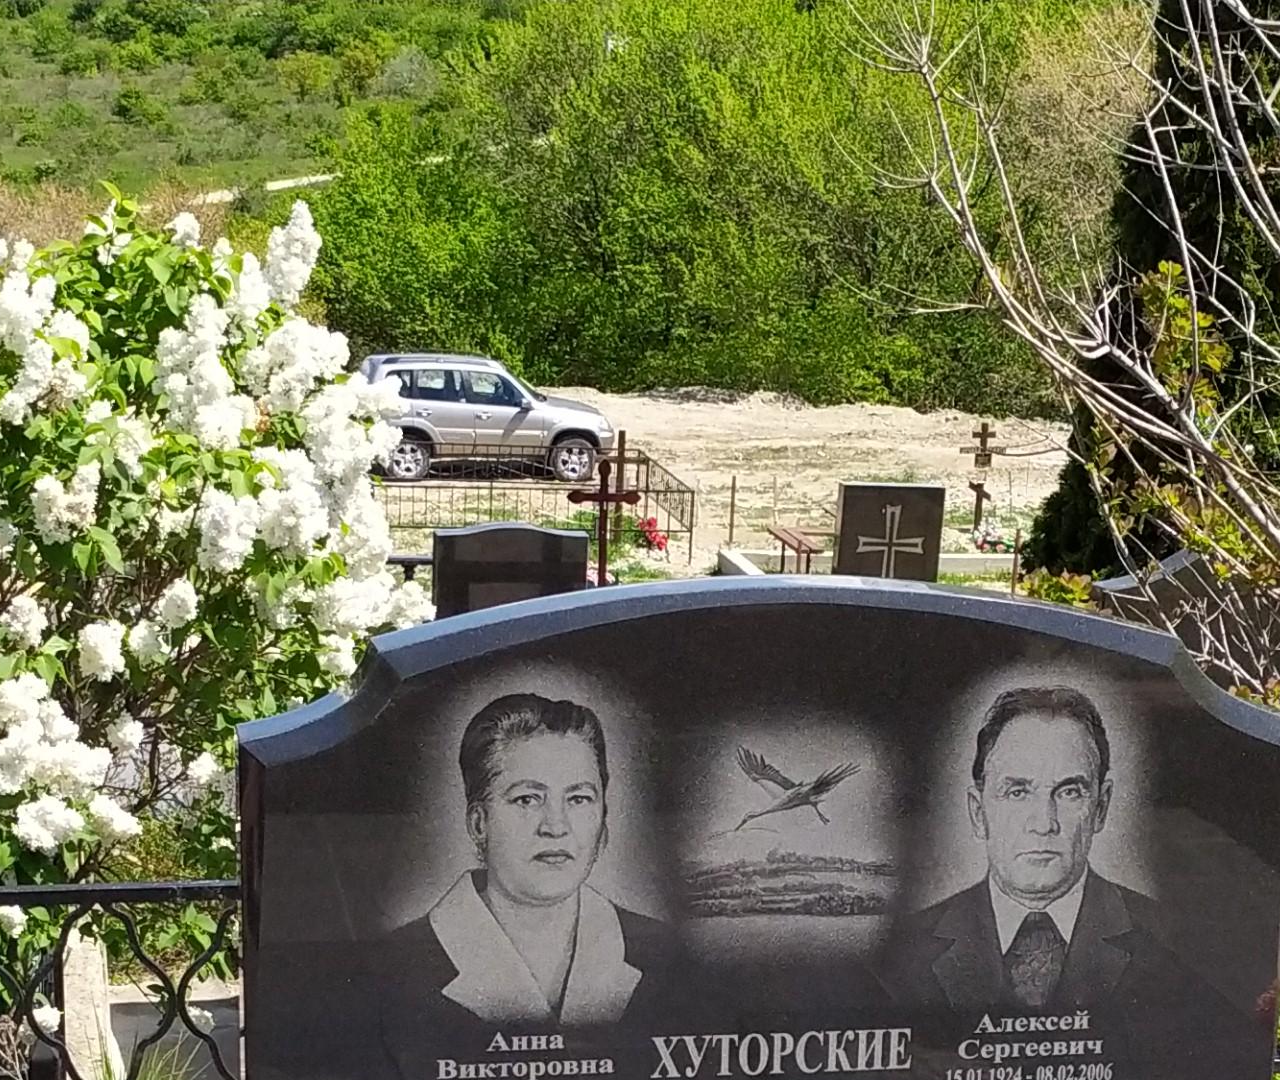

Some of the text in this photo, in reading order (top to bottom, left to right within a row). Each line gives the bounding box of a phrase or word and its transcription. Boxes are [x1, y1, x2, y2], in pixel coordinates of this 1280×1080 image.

[974, 1010, 1091, 1034] Алексей
[486, 1031, 565, 1052] Анна
[650, 1027, 913, 1080] ХУТОРСКИЕ
[958, 1039, 1104, 1064] Сергеевич
